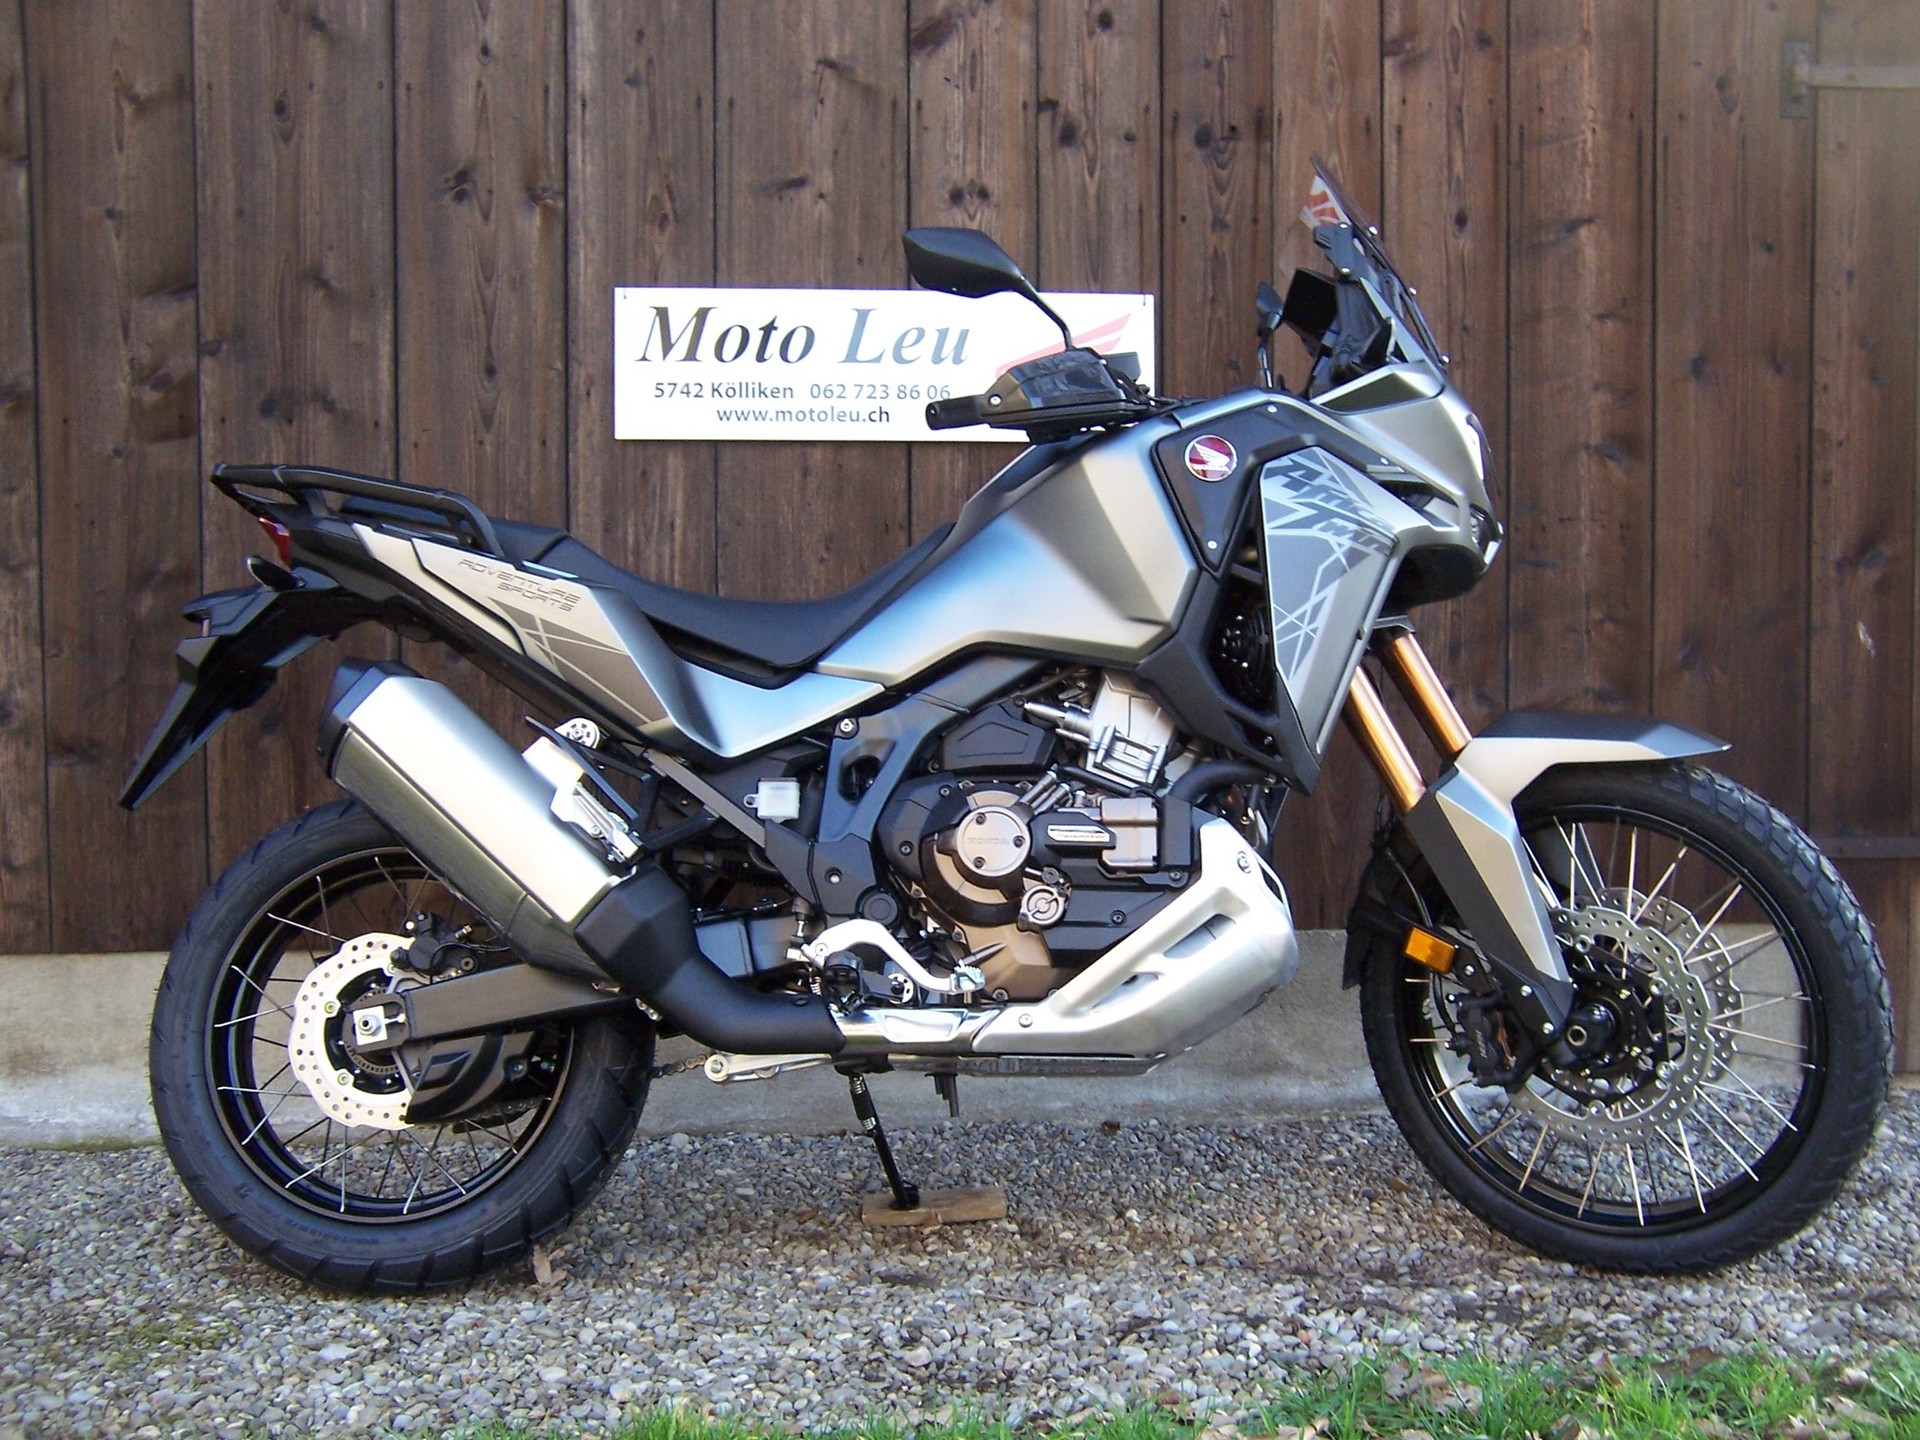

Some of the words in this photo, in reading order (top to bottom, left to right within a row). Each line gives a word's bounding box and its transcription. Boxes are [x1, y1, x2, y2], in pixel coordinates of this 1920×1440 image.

[635, 305, 816, 365] Moto
[837, 308, 972, 366] Leu
[653, 382, 704, 399] 5742
[711, 381, 794, 399] Kölliken
[810, 383, 847, 400] 062
[853, 384, 890, 400] 723
[896, 384, 921, 400] 86
[926, 384, 952, 400] 06
[716, 405, 890, 423] www.motoleu.ch
[458, 559, 581, 604] ADVENTURE
[496, 581, 576, 613] SPORTS
